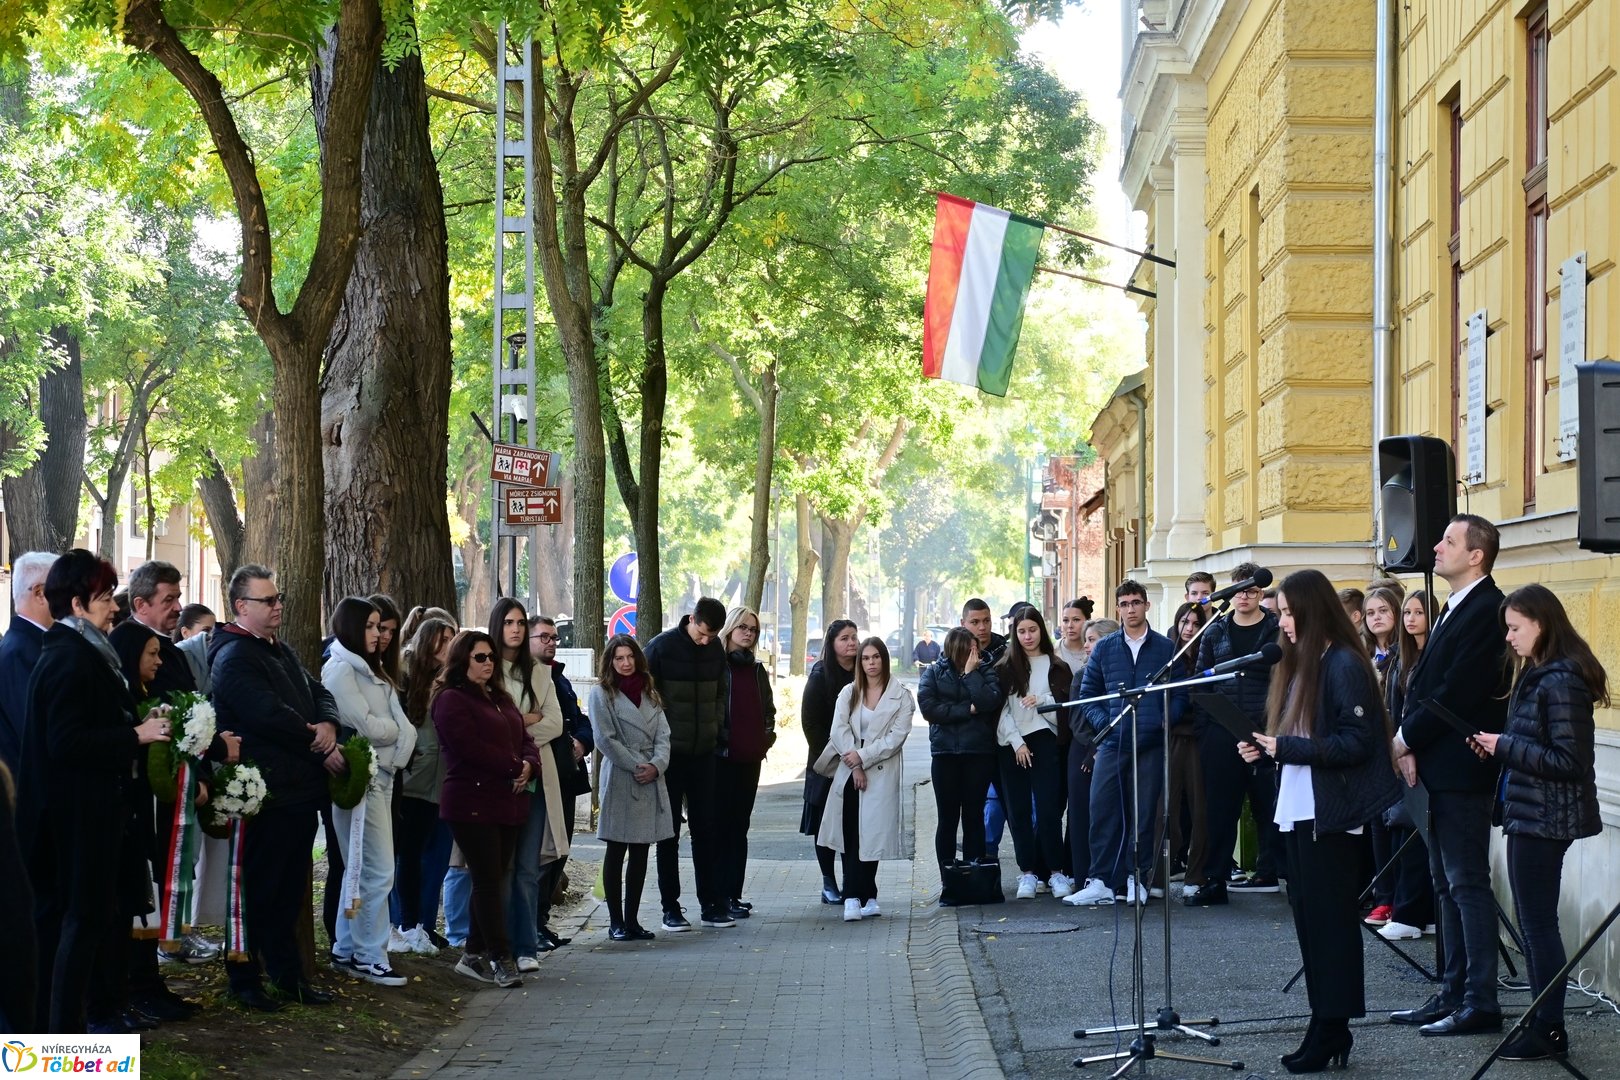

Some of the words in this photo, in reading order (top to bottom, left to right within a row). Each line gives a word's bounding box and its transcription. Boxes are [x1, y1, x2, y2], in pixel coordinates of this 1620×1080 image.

[495, 447, 512, 455] MÁRIA
[513, 449, 548, 461] ZARÁNDOKÚT
[512, 475, 533, 484] MARIAE
